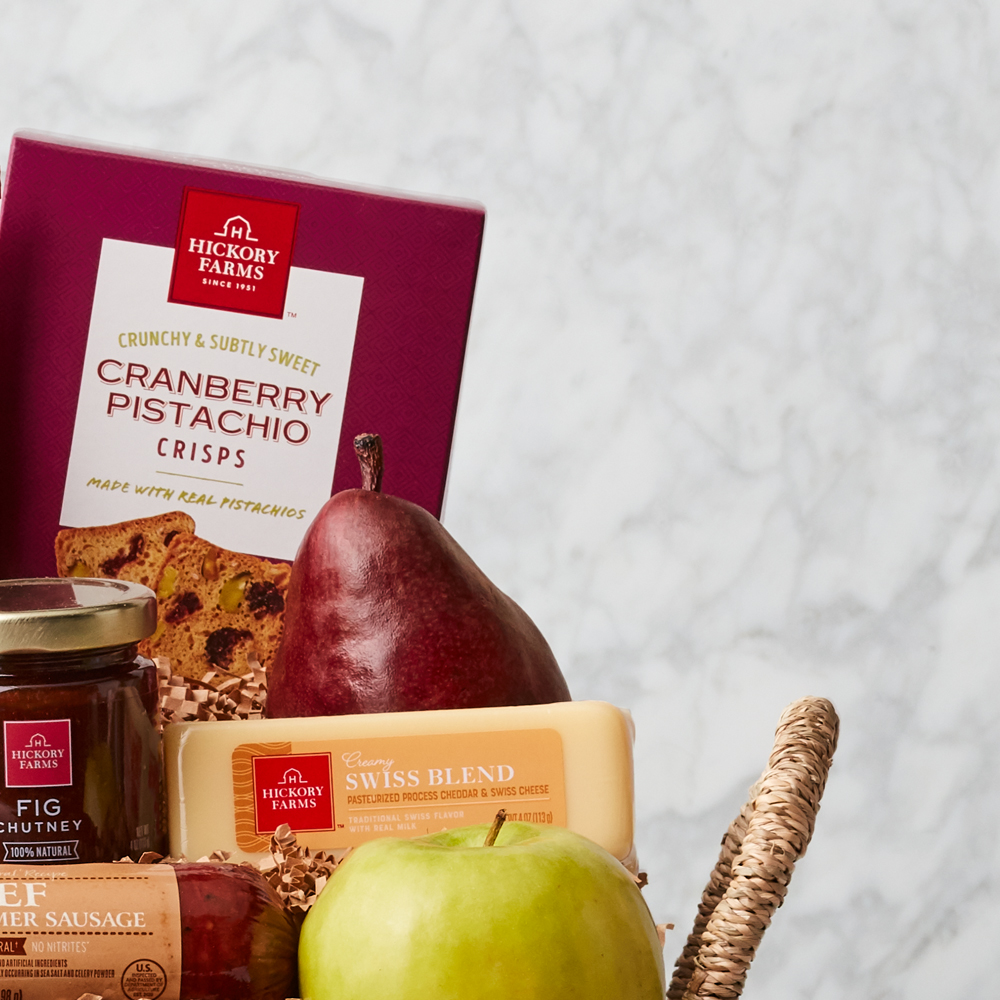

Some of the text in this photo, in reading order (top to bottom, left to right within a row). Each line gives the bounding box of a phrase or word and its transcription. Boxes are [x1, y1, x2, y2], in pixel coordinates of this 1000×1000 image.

[231, 227, 242, 239] H
[188, 238, 280, 265] HICKORY
[198, 258, 264, 280] FARMS
[202, 278, 256, 292] SINCE 1951
[119, 331, 321, 377] CRUNCHY & SUBTLY SWEET
[97, 359, 333, 416] CRANBERRY
[106, 392, 311, 446] PISTACHIO
[157, 437, 246, 469] CRISPS
[87, 477, 306, 520] MADE WITH REAL PISTACHIOS
[12, 749, 65, 759] HICKORY
[20, 760, 58, 769] FARMS
[342, 751, 395, 772] Creamy
[289, 776, 297, 784] H
[346, 765, 515, 791] SWISS BLEND
[263, 786, 324, 799] HICKORY
[348, 785, 550, 805] PASTEURIZED PROCESS CHEDDAR & SWISS CHEESE
[17, 798, 61, 817] FIG
[272, 798, 317, 810] FARMS
[349, 811, 465, 825] TRADITIONAL SWISS FLAVOR
[349, 823, 417, 833] WITH REAL MILK
[11, 845, 72, 858] 100% NATURAL
[25, 869, 67, 882] Recipe
[46, 911, 147, 928] SAUSAGE
[31, 942, 45, 953] NO
[6, 959, 34, 968] ARTIFICIAL
[35, 959, 68, 968] INGREDIENTS
[136, 964, 153, 973] U.S.
[5, 969, 33, 978] OCCURRING
[40, 969, 50, 978] SEA
[51, 969, 63, 978] SALT
[63, 969, 74, 978] AND
[75, 969, 93, 978] CELERY
[94, 969, 115, 979] POWDER
